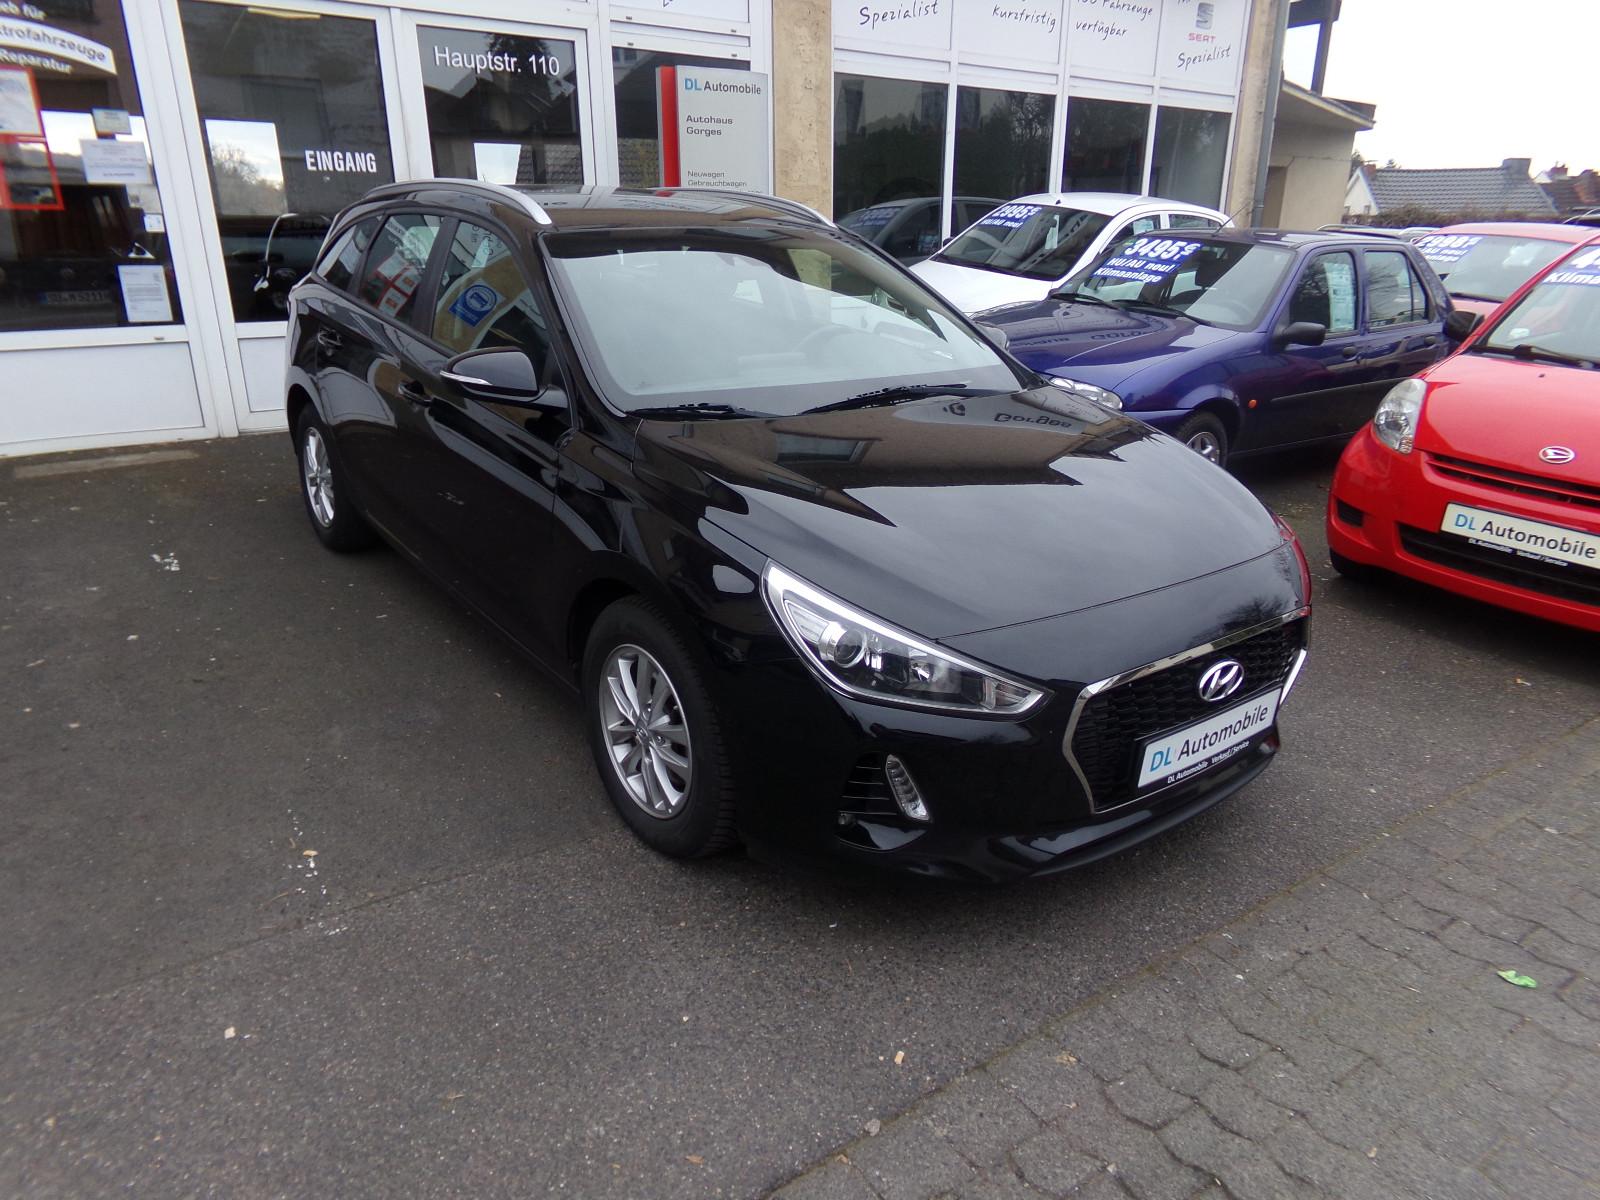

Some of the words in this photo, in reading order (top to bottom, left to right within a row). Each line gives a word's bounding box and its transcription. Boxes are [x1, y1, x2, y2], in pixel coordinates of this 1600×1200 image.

[22, 2, 46, 20] für
[859, 0, 939, 30] Spezialist
[992, 4, 1056, 33] Kurzfristig
[1075, 20, 1128, 40] verfügbar
[1188, 32, 1216, 42] SEAT
[434, 45, 522, 74] Hauptstr.
[528, 54, 560, 76] 110
[1177, 42, 1231, 72] Spezialist
[684, 78, 702, 91] DL
[704, 80, 761, 95] Automobile
[686, 114, 733, 125] Autohaus
[686, 126, 722, 137] Gorges
[305, 150, 377, 173] EINGANG
[687, 170, 725, 178] Neuwagen
[687, 179, 747, 188] Gebrauchtwagen
[1106, 257, 1146, 269] HU/AU
[1095, 267, 1163, 283] Klimaanlage
[1454, 513, 1477, 531] DL
[1481, 520, 1597, 559] Automobile
[1150, 746, 1172, 773] DL
[1178, 704, 1268, 761] Automobile
[1176, 760, 1209, 781] Automobile
